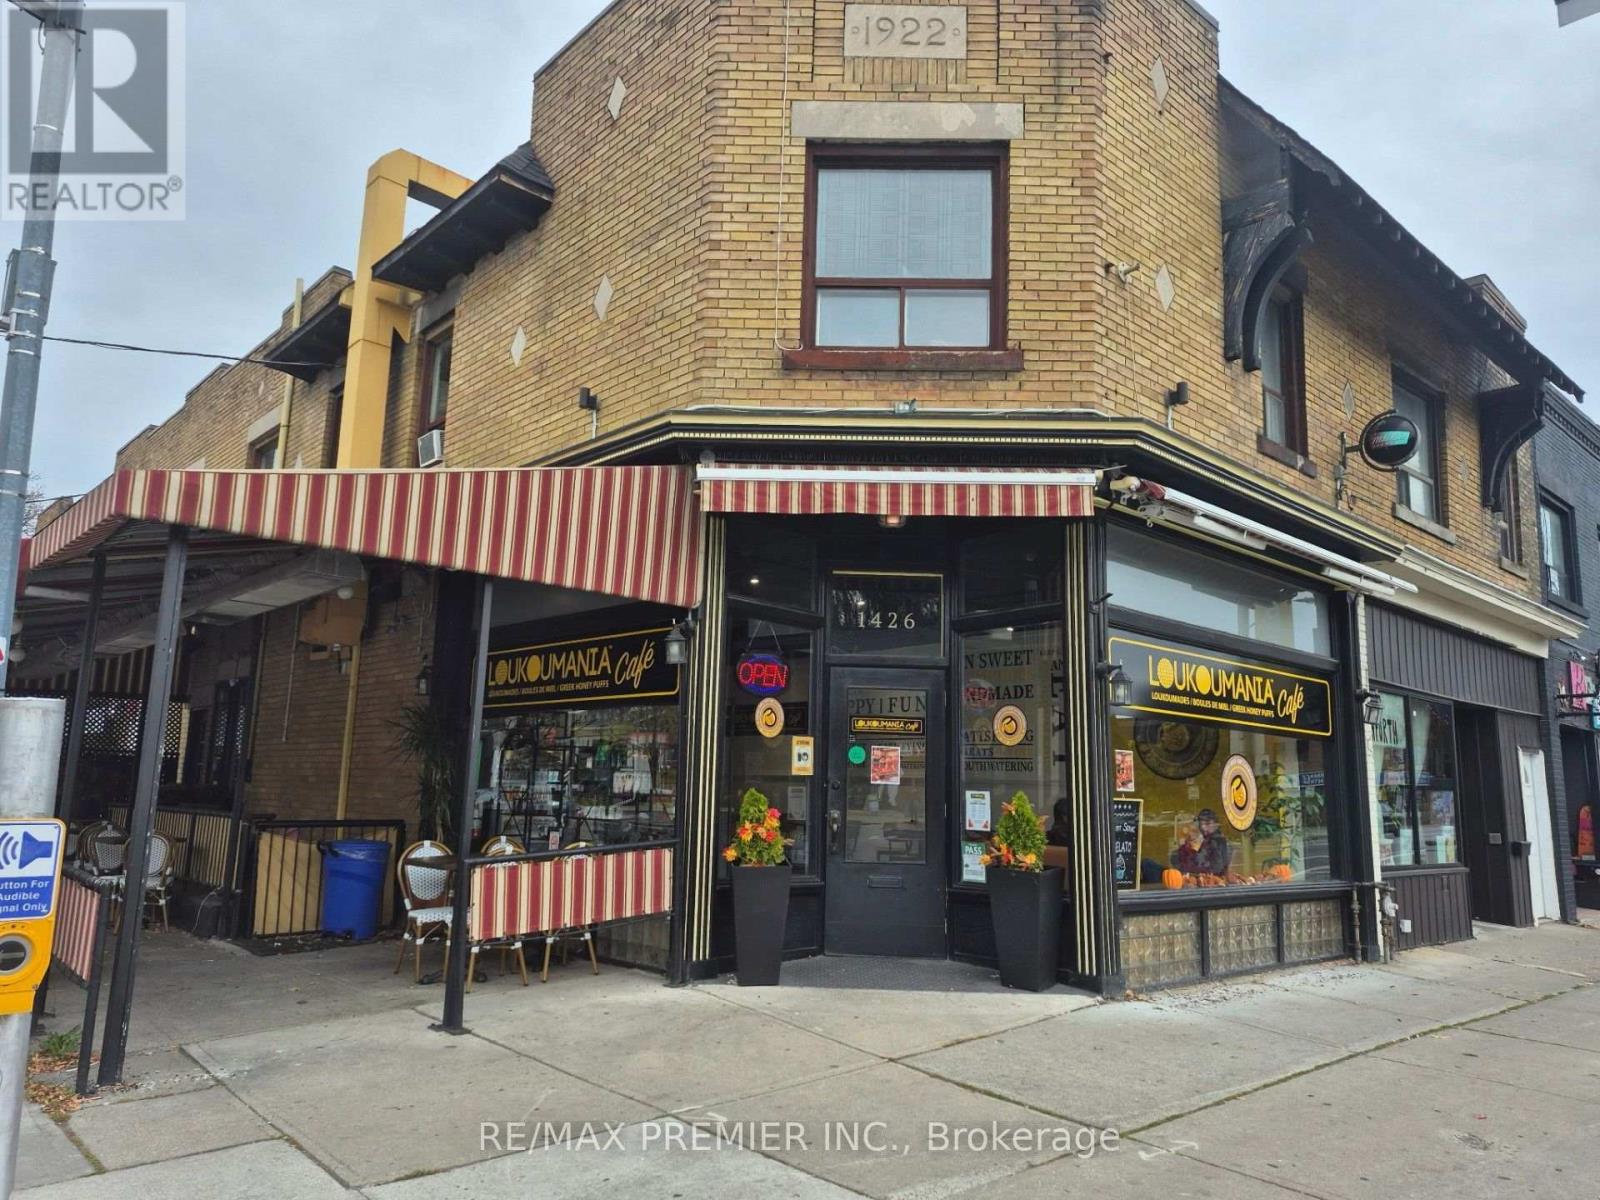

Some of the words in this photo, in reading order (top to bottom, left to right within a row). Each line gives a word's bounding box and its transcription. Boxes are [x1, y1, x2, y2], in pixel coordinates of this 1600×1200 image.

[865, 16, 946, 46] 1922
[858, 611, 916, 630] 1426
[488, 646, 612, 686] LOUKOUMANIA
[614, 639, 656, 689] Café
[978, 649, 1033, 669] SWEET
[739, 662, 788, 688] OPEN
[1148, 655, 1275, 706] LOUKOUMANIA
[1277, 683, 1305, 724] Café
[887, 695, 926, 713] FUN
[965, 846, 983, 855] PASS
[31, 880, 50, 889] For
[22, 902, 48, 914] Only
